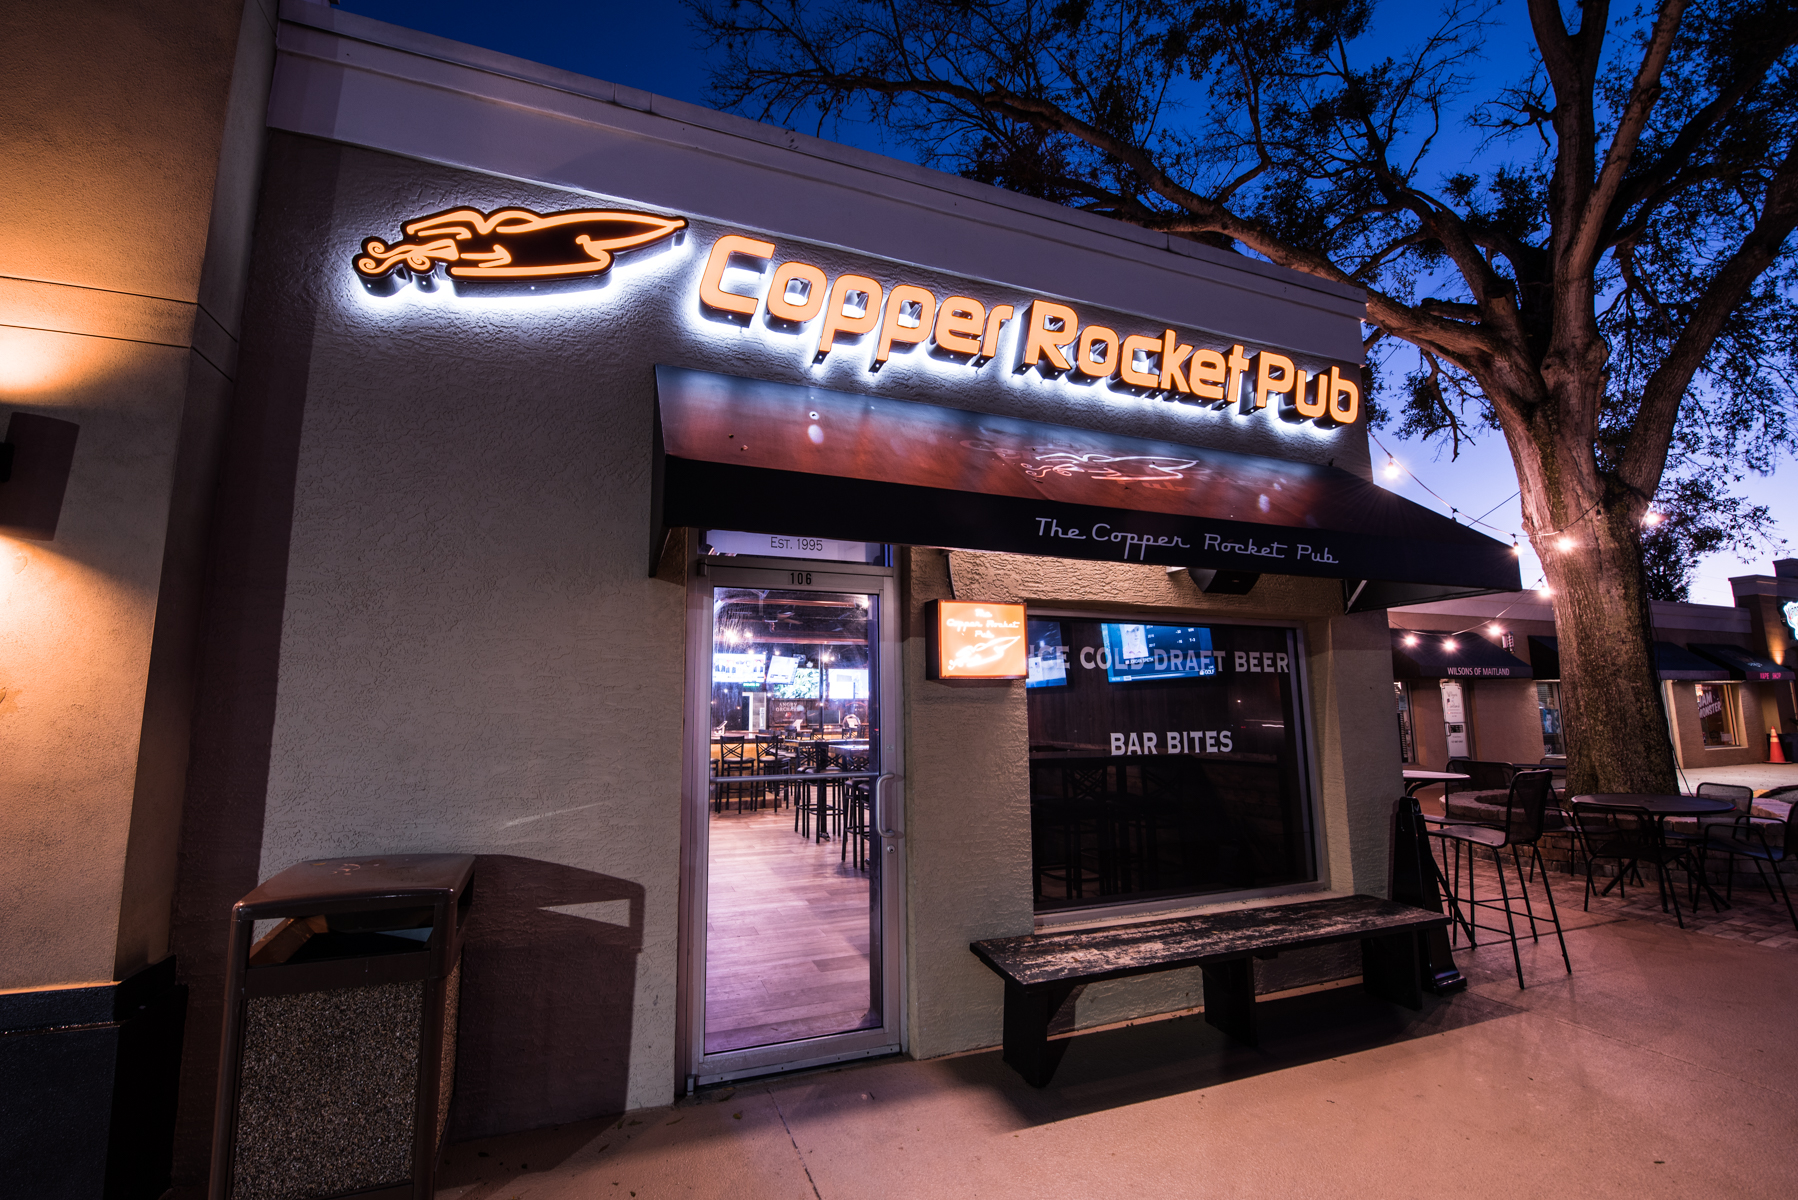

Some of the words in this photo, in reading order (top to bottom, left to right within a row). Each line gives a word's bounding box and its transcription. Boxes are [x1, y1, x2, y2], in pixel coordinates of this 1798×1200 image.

[699, 234, 1014, 362] Copper
[1026, 299, 1248, 403] Rocket
[1256, 350, 1360, 425] Pub
[770, 536, 793, 549] EST.
[796, 538, 823, 551] 1995
[1035, 517, 1086, 539] The
[1091, 523, 1191, 560] Copper
[1204, 533, 1288, 558] Rocket
[1296, 544, 1339, 564] Pub
[789, 572, 812, 585] 106
[1080, 646, 1145, 670] COLD
[1153, 649, 1226, 672] DRAFT
[1234, 651, 1290, 673] BEER
[1447, 667, 1473, 676] WILSONS
[1474, 667, 1482, 676] OF
[1483, 667, 1510, 676] MAITLAND
[1110, 732, 1158, 756] BAR
[1166, 730, 1233, 754] BITES
